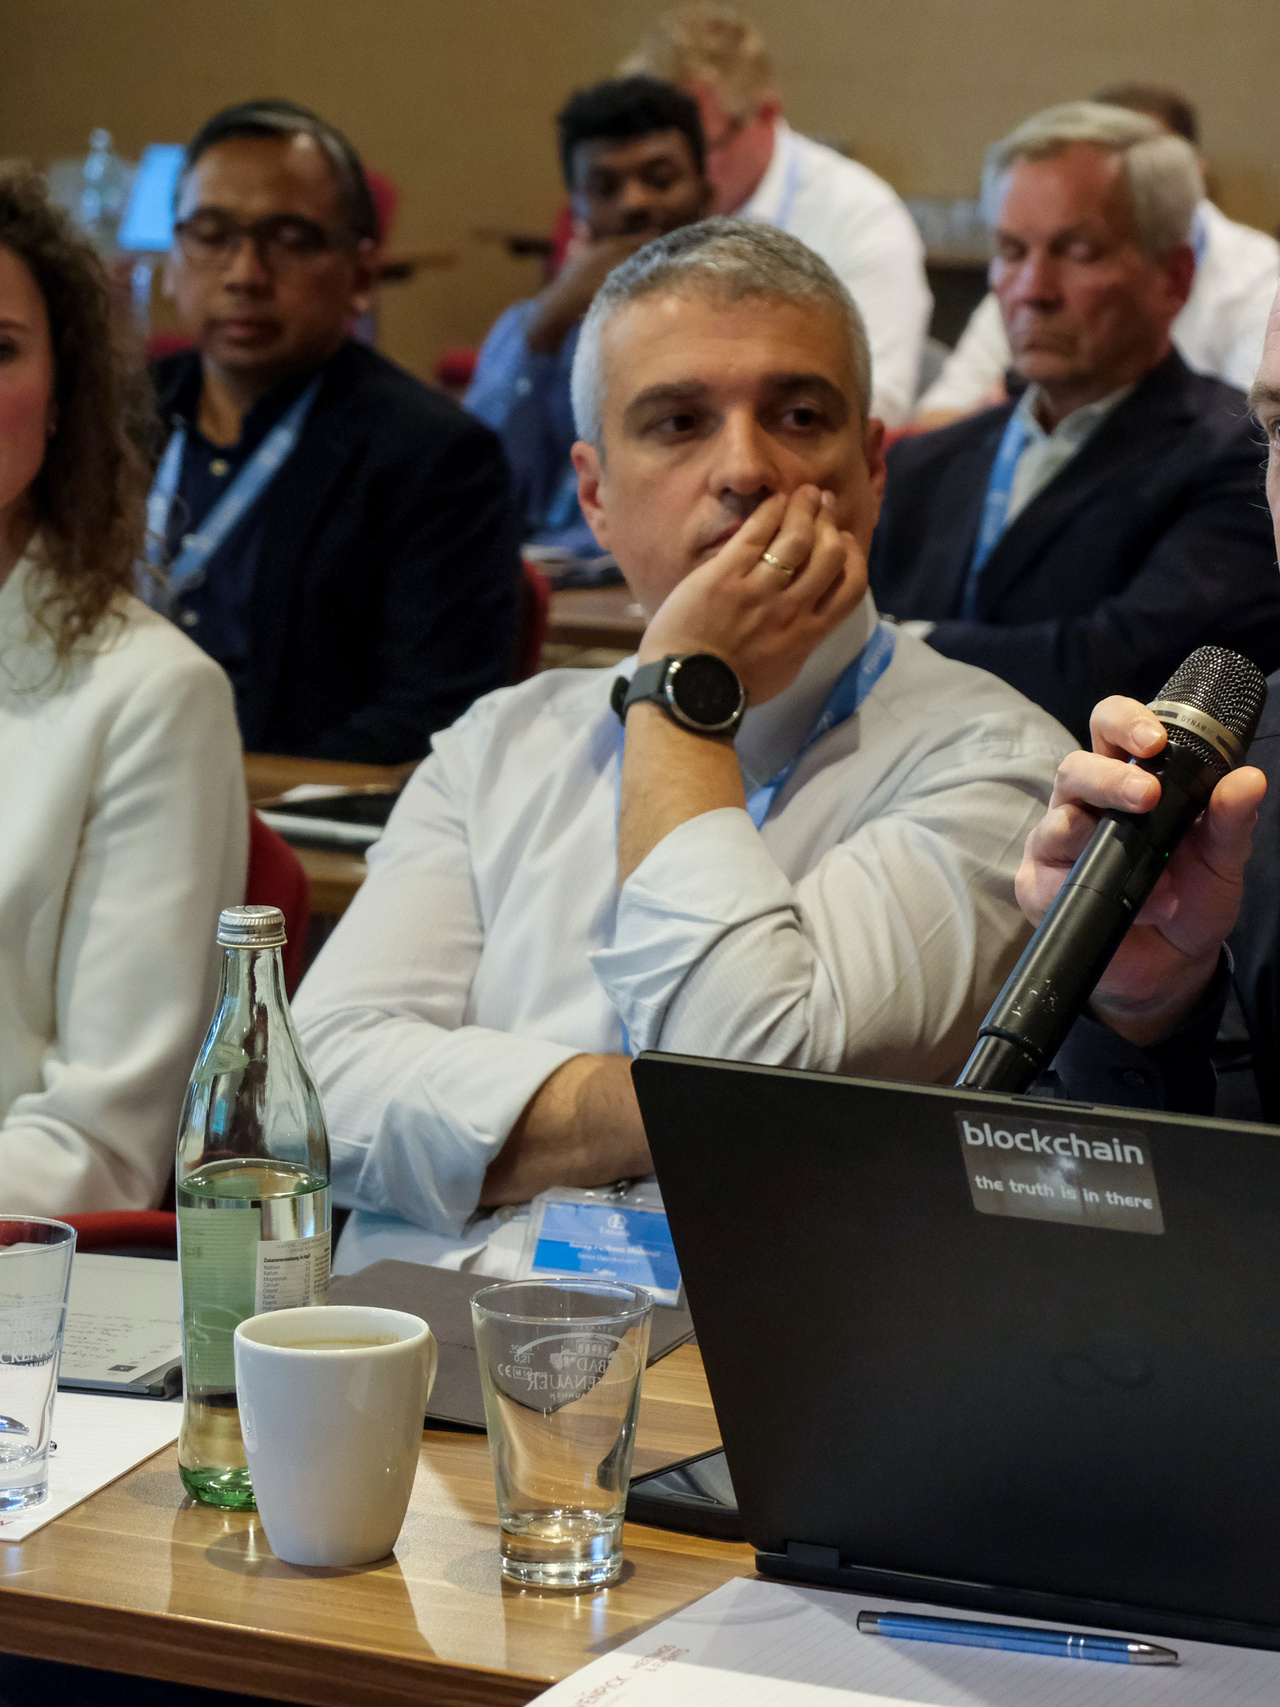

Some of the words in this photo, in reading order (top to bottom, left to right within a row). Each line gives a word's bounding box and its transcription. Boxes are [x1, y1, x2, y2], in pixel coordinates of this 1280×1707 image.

[1180, 715, 1215, 737] DYNAMIC
[962, 1120, 1144, 1165] blockchain
[974, 1175, 1004, 1192] the
[1009, 1179, 1055, 1198] truth
[1061, 1185, 1078, 1200] is
[1083, 1188, 1099, 1203] in
[1106, 1191, 1153, 1210] there
